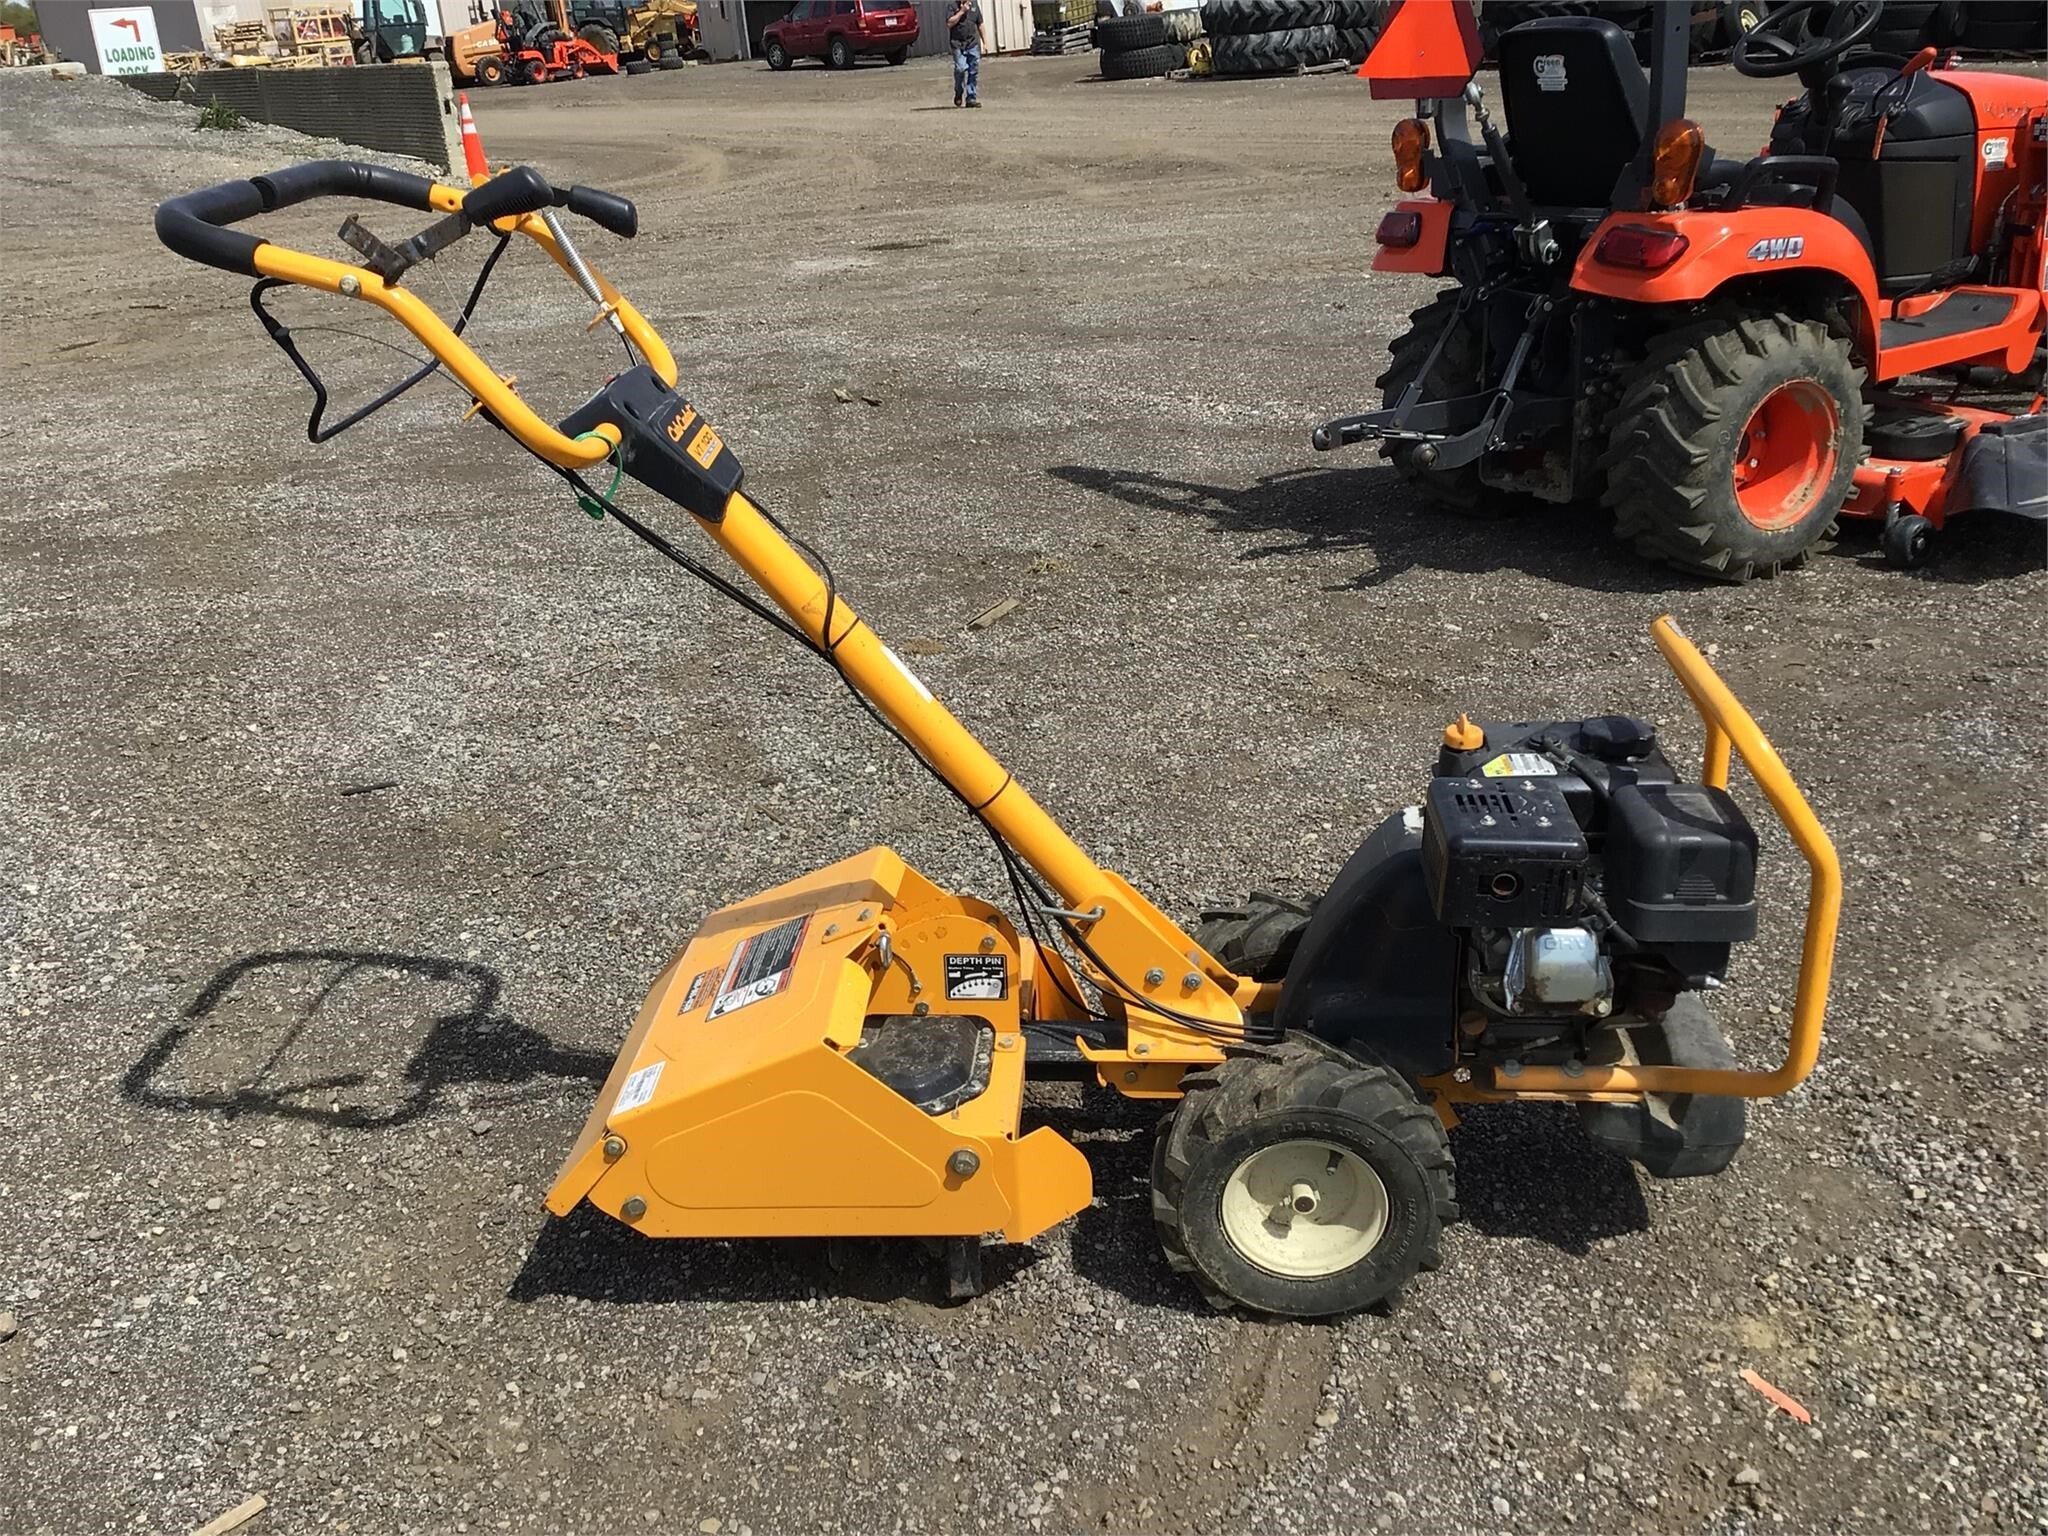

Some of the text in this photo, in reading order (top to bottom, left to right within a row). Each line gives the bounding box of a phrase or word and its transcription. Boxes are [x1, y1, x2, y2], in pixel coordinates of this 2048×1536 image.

[104, 46, 156, 63] LOADING
[1747, 236, 1804, 261] 4WD
[949, 957, 1002, 965] DEPTH PIN
